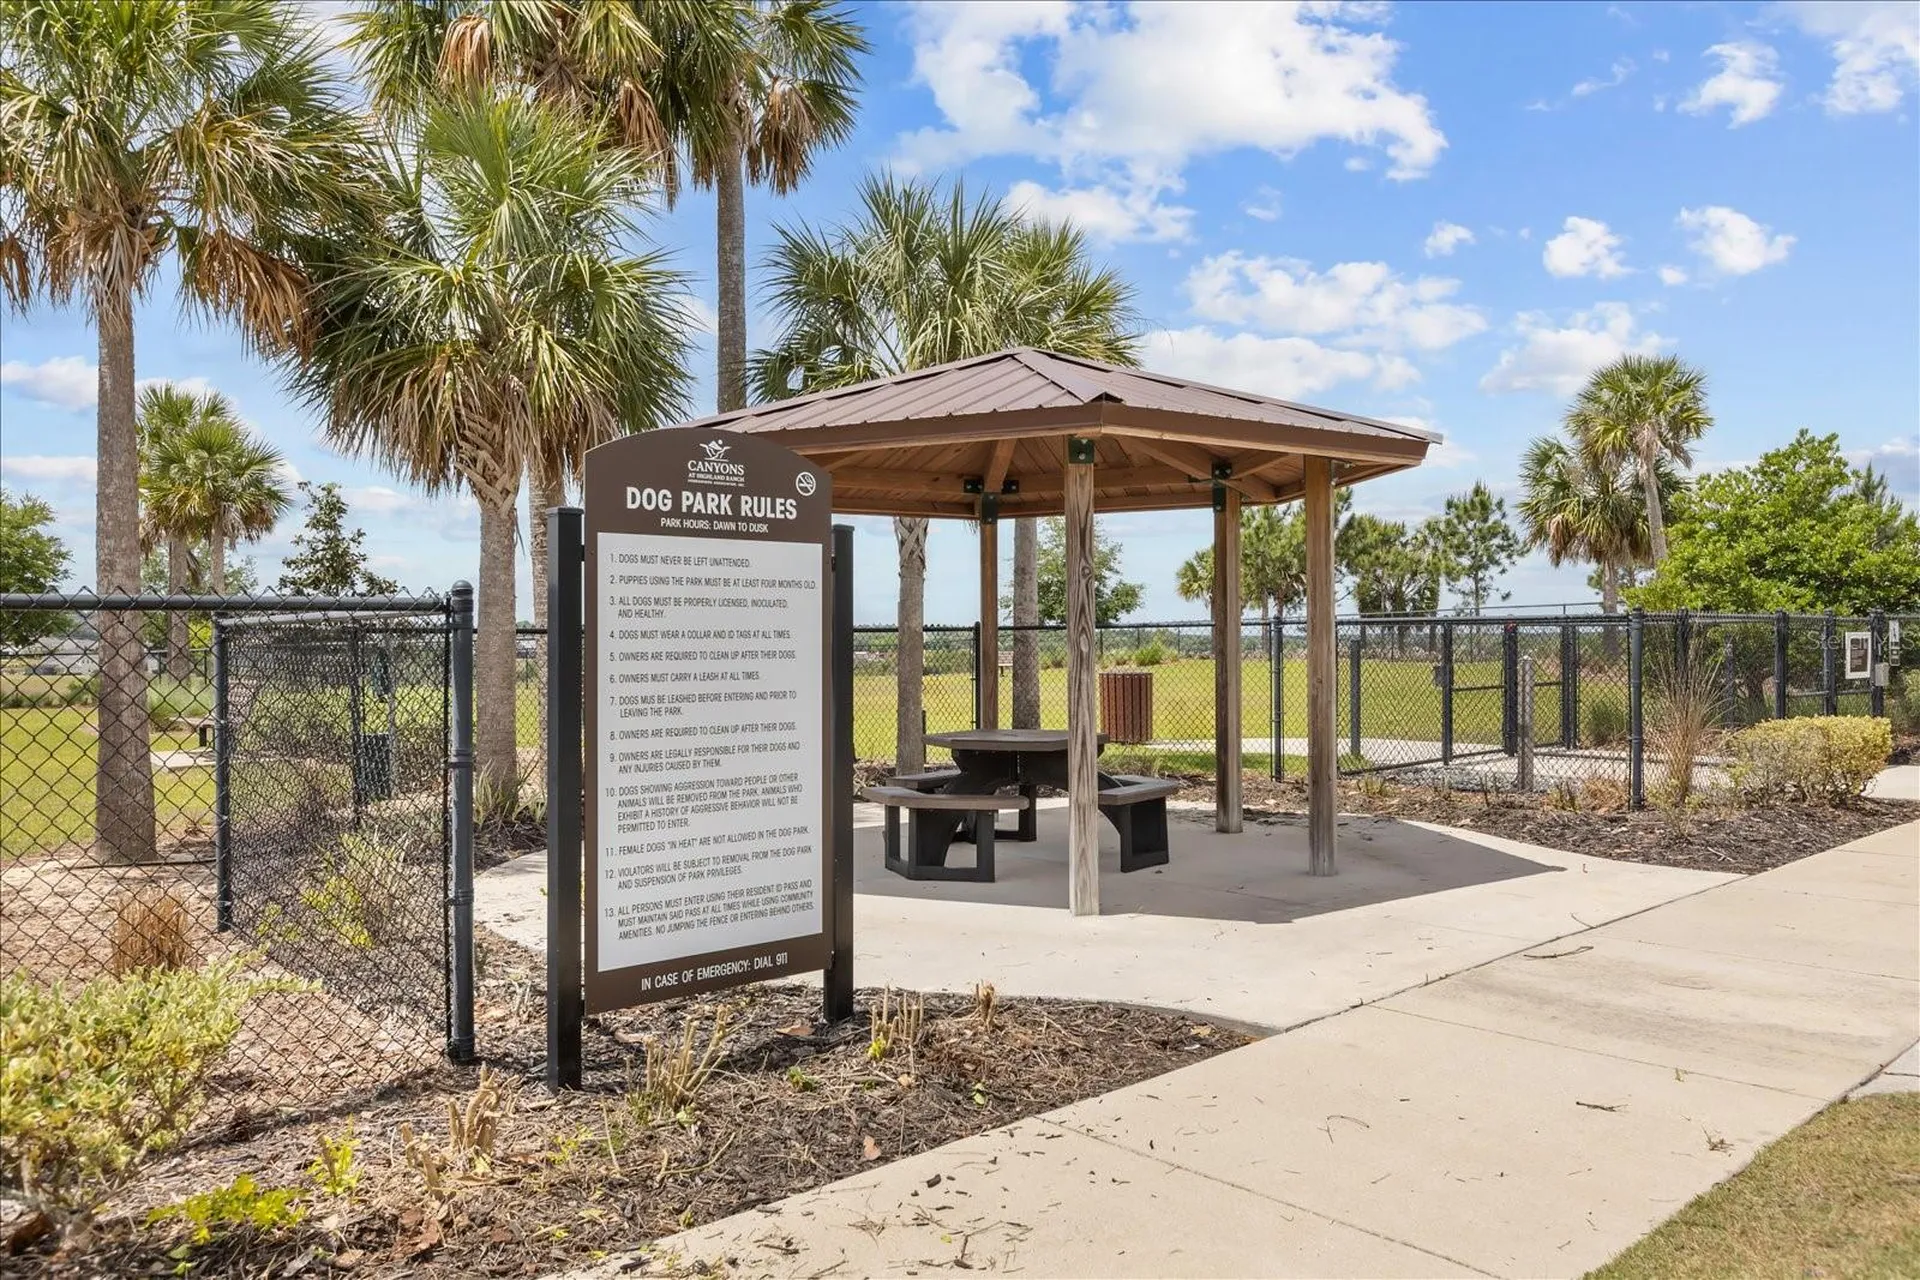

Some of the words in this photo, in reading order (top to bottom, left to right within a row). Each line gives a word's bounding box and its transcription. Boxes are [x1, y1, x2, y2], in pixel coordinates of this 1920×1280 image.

[688, 460, 745, 475] CANYONS
[626, 487, 672, 511] DOG
[681, 491, 733, 515] PARK
[740, 495, 797, 520] RULES
[660, 517, 681, 528] PARK
[683, 518, 711, 530] HOURS:
[713, 520, 736, 531] DAWN
[737, 522, 747, 531] TO
[749, 523, 768, 533] DUSK
[610, 553, 616, 563] 1.
[618, 553, 638, 564] DOGS
[639, 554, 658, 564] MUST
[659, 555, 681, 565] NEVER
[683, 556, 691, 565] BE
[693, 556, 707, 566] LEFT
[610, 574, 616, 584] 2.
[618, 574, 647, 585] PUPPIES
[648, 575, 669, 586] USING
[671, 576, 684, 586] THE
[685, 576, 702, 587] PARK
[703, 577, 721, 587] MUST
[722, 577, 731, 587] BE
[732, 578, 740, 588] AT
[741, 578, 759, 588] LEAST
[760, 578, 776, 588] FOUR
[777, 579, 802, 589] MONTHS
[617, 608, 633, 618] AND
[610, 629, 616, 640] 4.
[618, 629, 638, 640] DOGS
[639, 629, 658, 640] MUST
[659, 629, 679, 639] WEAR
[681, 629, 685, 639] A
[686, 629, 711, 639] COLLAR
[712, 629, 726, 639] AND
[727, 629, 734, 639] ID
[736, 629, 751, 639] TAGS
[752, 629, 759, 639] AT
[761, 629, 771, 639] ALL
[610, 651, 616, 662] 5.
[618, 651, 649, 662] OWNERS
[650, 651, 663, 661] ARE
[664, 650, 697, 661] REQUIRED
[699, 650, 707, 660] TO
[708, 650, 729, 660] CLEAN
[730, 650, 739, 660] UP
[740, 650, 758, 660] AFTER
[760, 650, 777, 659] THEIR
[610, 674, 616, 684] 6.
[618, 673, 649, 684] OWNERS
[650, 672, 668, 683] MUST
[670, 672, 691, 682] CARRY
[693, 672, 697, 682] A
[698, 671, 719, 681] LEASH
[720, 671, 727, 681] AT
[728, 671, 739, 681] ALL
[610, 695, 616, 706] 7.
[618, 695, 639, 706] DOGS
[640, 694, 655, 705] MUS
[656, 694, 666, 704] BE
[667, 693, 696, 704] LEASHED
[697, 692, 722, 703] BEFORE
[723, 691, 753, 702] ENTERING
[755, 690, 768, 700] AND
[769, 690, 787, 700] PRIOR
[789, 689, 796, 699] TO
[619, 707, 648, 718] LEAVING
[649, 706, 662, 716] THE
[610, 730, 616, 741] 8.
[618, 728, 649, 740] OWNERS
[650, 728, 663, 739] ARE
[664, 726, 698, 738] REQUIRED
[699, 725, 708, 736] TO
[708, 724, 729, 735] CLEAN
[730, 724, 739, 734] UP
[740, 723, 759, 733] AFTER
[760, 722, 777, 732] THEIR
[610, 752, 616, 763] 9.
[618, 750, 648, 762] OWNERS
[650, 749, 663, 760] ARE
[664, 747, 692, 759] LEGALLY
[693, 744, 735, 757] RESPONSIBLE
[737, 744, 749, 754] FOR
[751, 742, 768, 753] THEIR
[769, 741, 786, 752] DOGS
[787, 740, 800, 751] AND
[618, 763, 632, 774] ANY
[633, 761, 663, 773] INJURIES
[664, 759, 690, 771] CAUSED
[692, 759, 701, 769] BY
[604, 787, 616, 798] 10.
[618, 785, 638, 797] DOGS
[639, 782, 672, 795] SHOWING
[673, 779, 714, 792] AGGRESSION
[716, 776, 743, 789] TOWARD
[743, 774, 766, 786] PEOPLE
[768, 774, 777, 784] OR
[778, 772, 798, 783] OTHER
[617, 820, 655, 834] PERMITTED
[656, 819, 666, 830] TO
[604, 846, 616, 858] 11.
[618, 843, 644, 856] FEMALE
[646, 841, 665, 853] DOGS
[698, 836, 710, 847] ARE
[712, 834, 725, 845] NOT
[727, 831, 756, 843] ALLOWED
[757, 830, 764, 840] IN
[765, 828, 776, 839] THE
[778, 827, 791, 837] DOG
[604, 868, 616, 880] 12.
[617, 863, 654, 878] VIOLATORS
[655, 861, 670, 873] WILL
[672, 860, 681, 871] BE
[682, 856, 710, 870] SUBJECT
[712, 855, 720, 866] TO
[721, 852, 749, 865] REMOVAL
[751, 849, 768, 861] FROM
[769, 848, 780, 859] THE
[782, 846, 795, 857] DOG
[796, 844, 811, 855] PARK
[617, 878, 632, 890] AND
[634, 872, 676, 888] SUSPENSION
[677, 871, 686, 882] OF
[687, 869, 705, 881] PARK
[641, 977, 651, 990] IN
[655, 972, 679, 988] CASE
[682, 969, 694, 983] OF
[697, 959, 750, 980] EMERGENCY:
[754, 955, 773, 970] DIAL
[775, 952, 788, 965] 911
